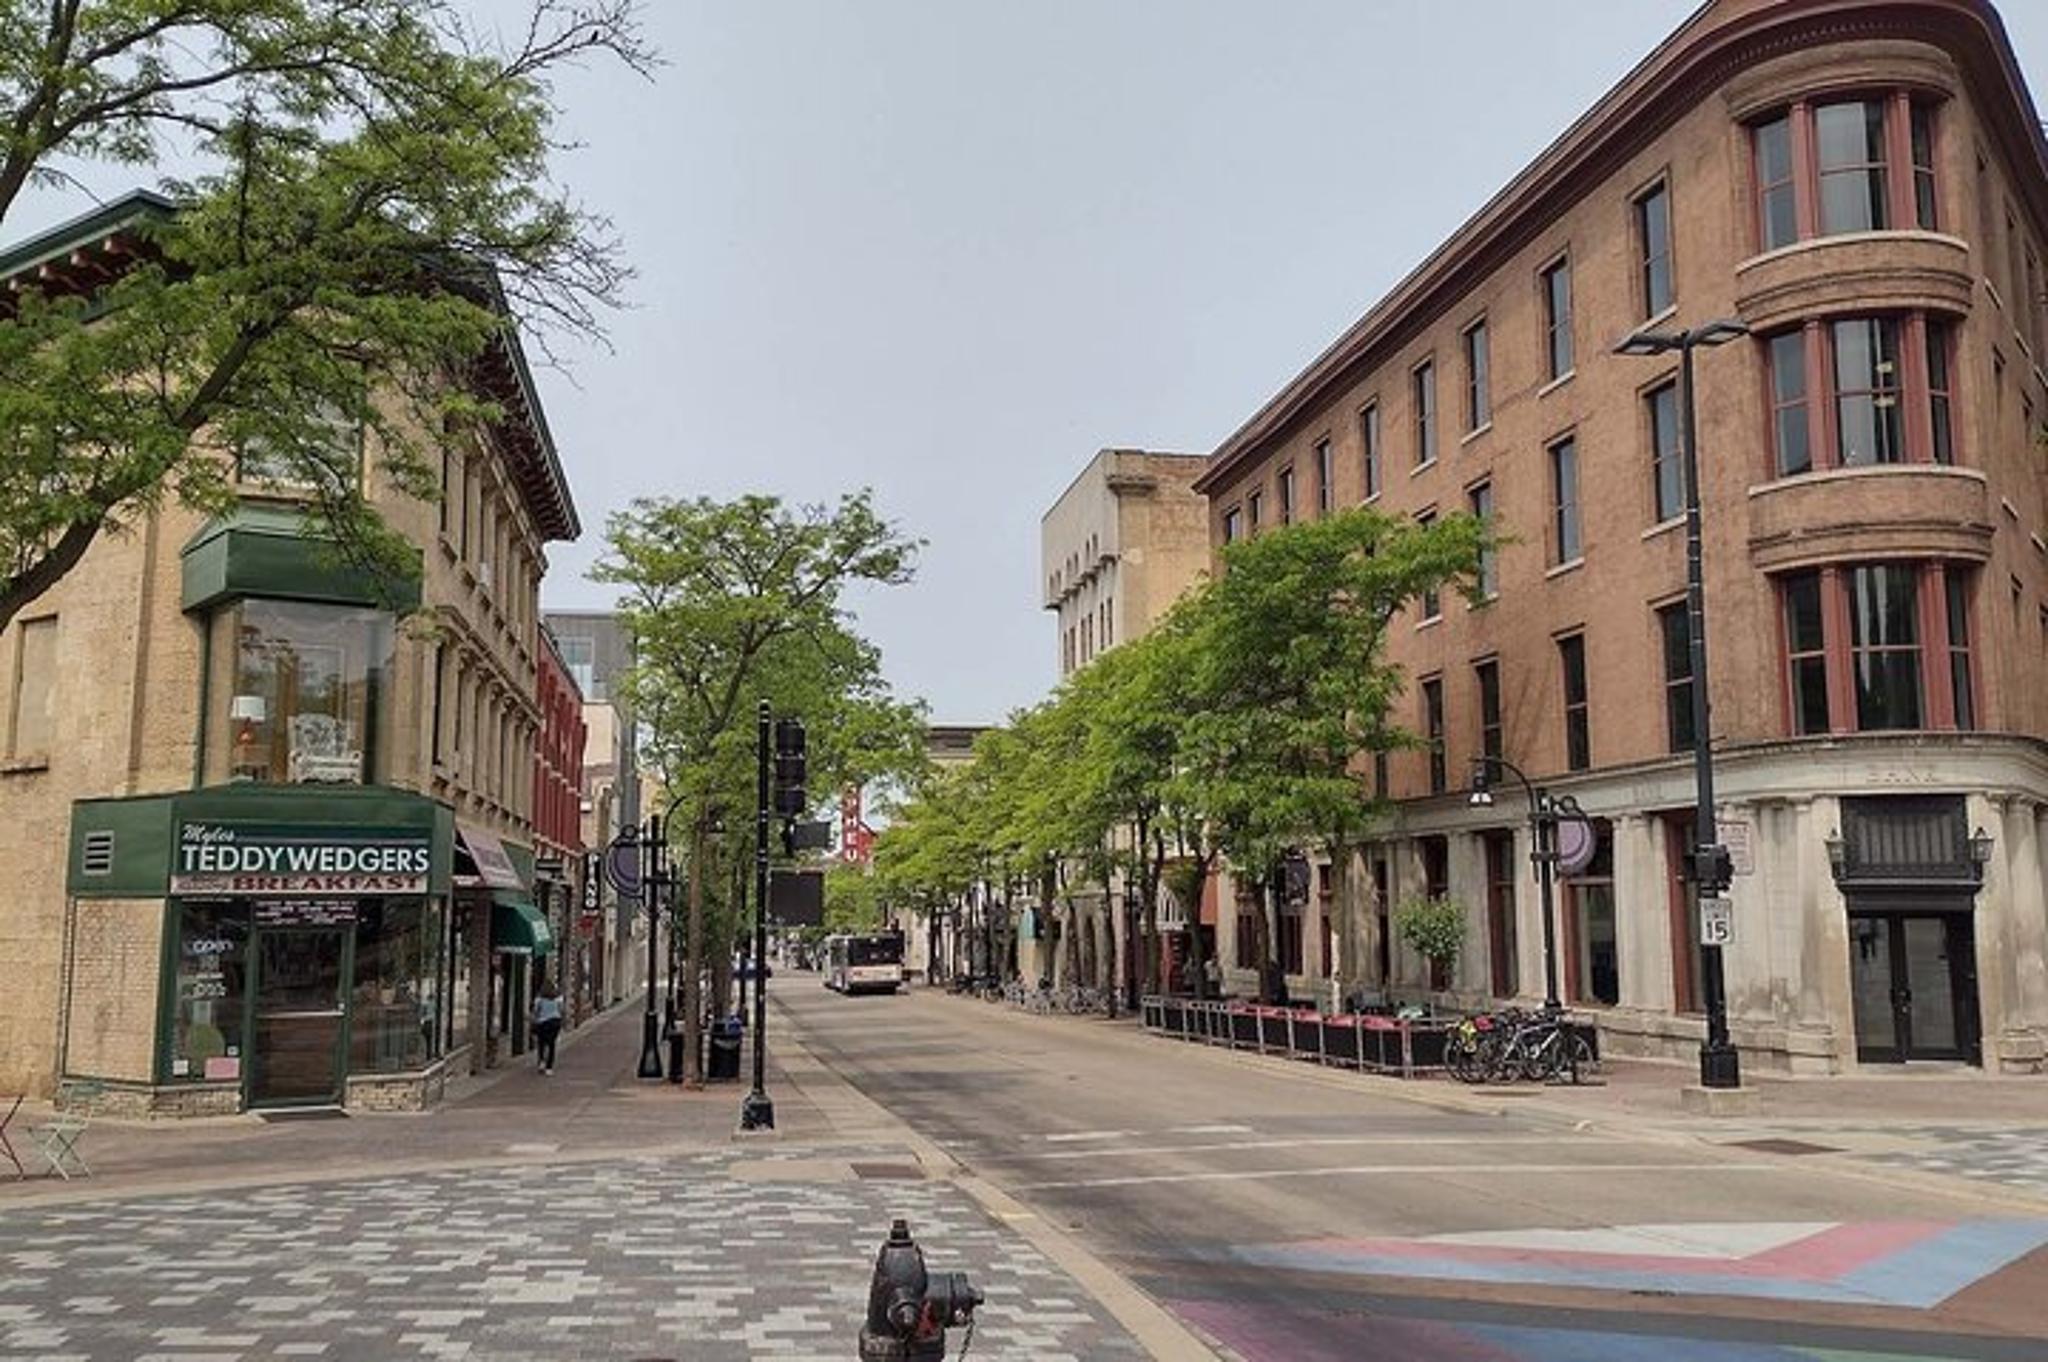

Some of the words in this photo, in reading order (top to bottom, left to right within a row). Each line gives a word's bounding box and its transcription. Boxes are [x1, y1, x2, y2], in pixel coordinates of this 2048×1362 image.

[182, 823, 235, 846] Myles
[181, 846, 429, 873] TEDDYWEDGERS
[233, 876, 417, 891] BREAKFAST
[1705, 920, 1728, 941] 15
